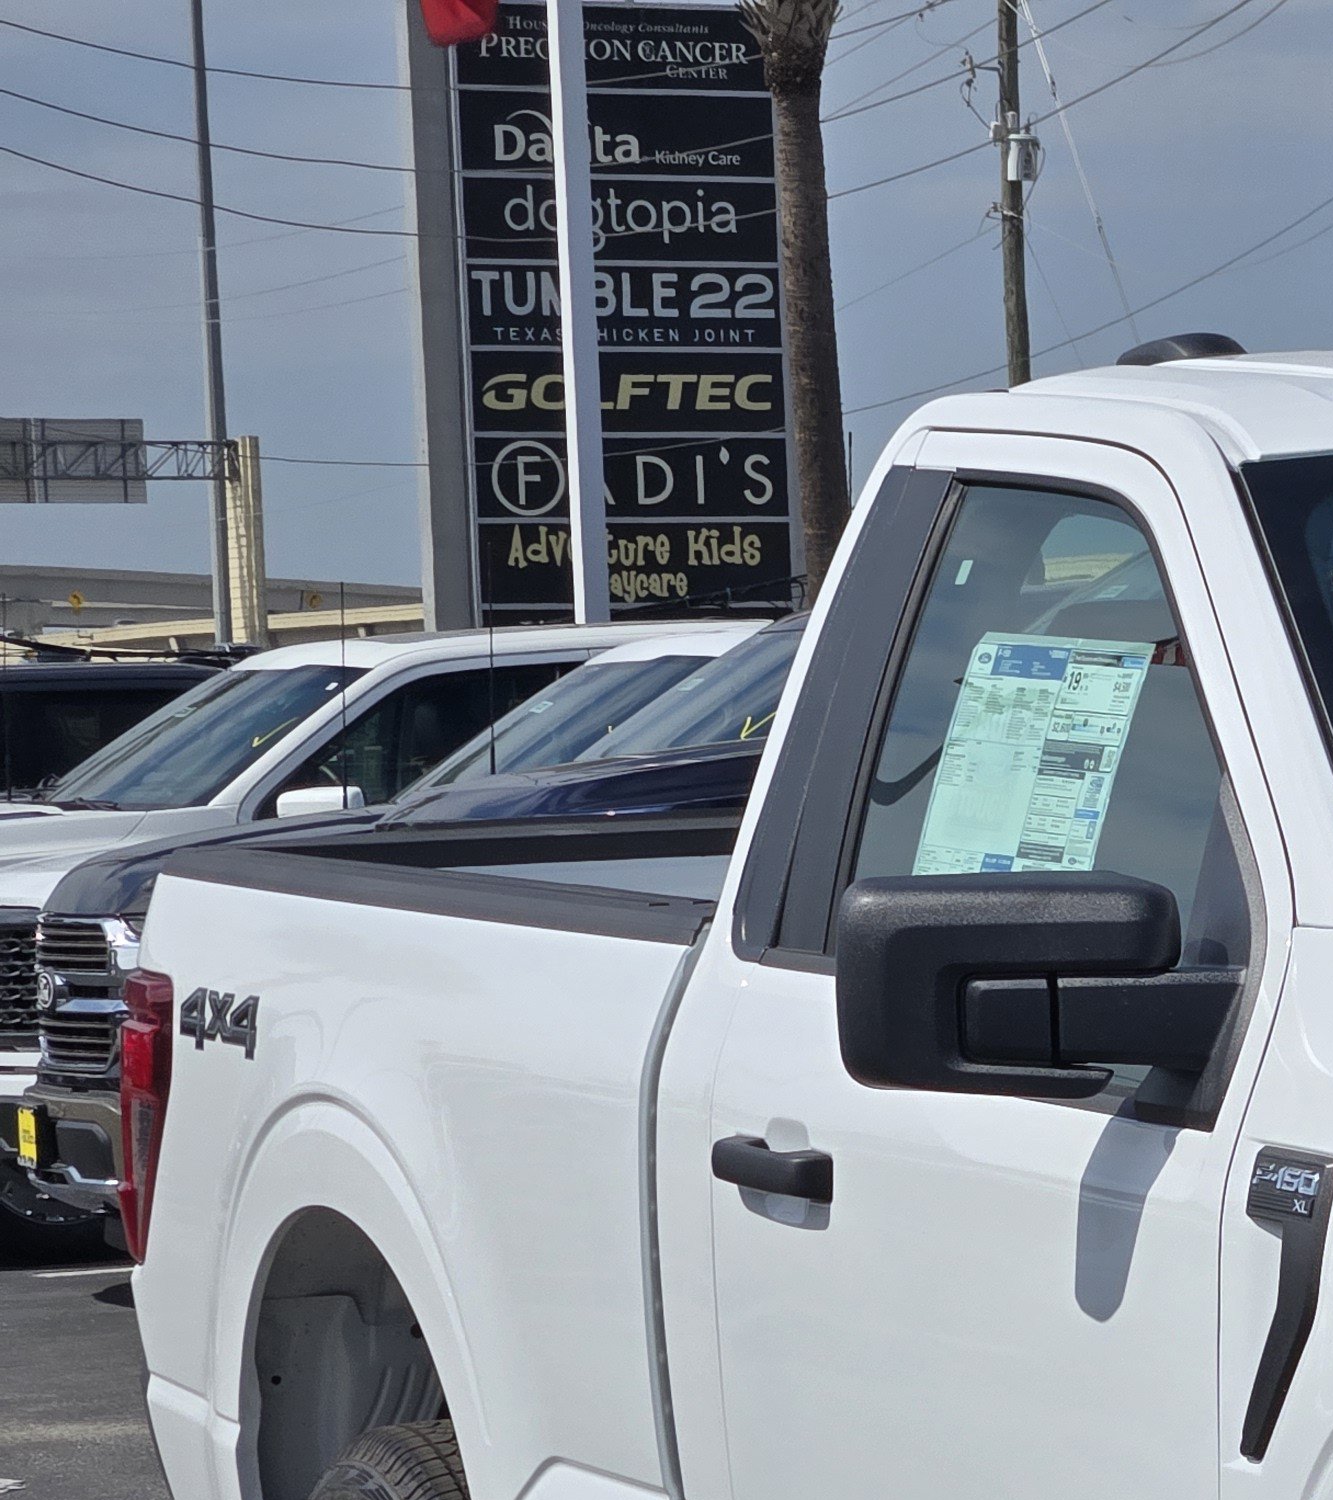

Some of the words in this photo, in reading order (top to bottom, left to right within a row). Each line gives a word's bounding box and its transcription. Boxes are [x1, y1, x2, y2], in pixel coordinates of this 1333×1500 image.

[638, 39, 748, 65] CANCER
[666, 64, 728, 80] CENTER
[494, 124, 641, 164] Data
[655, 149, 705, 167] Kidney
[708, 151, 741, 165] Care
[690, 272, 776, 318] 22
[598, 327, 680, 342] HICKEN
[693, 328, 755, 342] JOINT
[516, 446, 774, 506] FDI'S
[688, 526, 762, 568] Kids
[609, 569, 689, 604] aycare
[1292, 1198, 1308, 1215] XL
